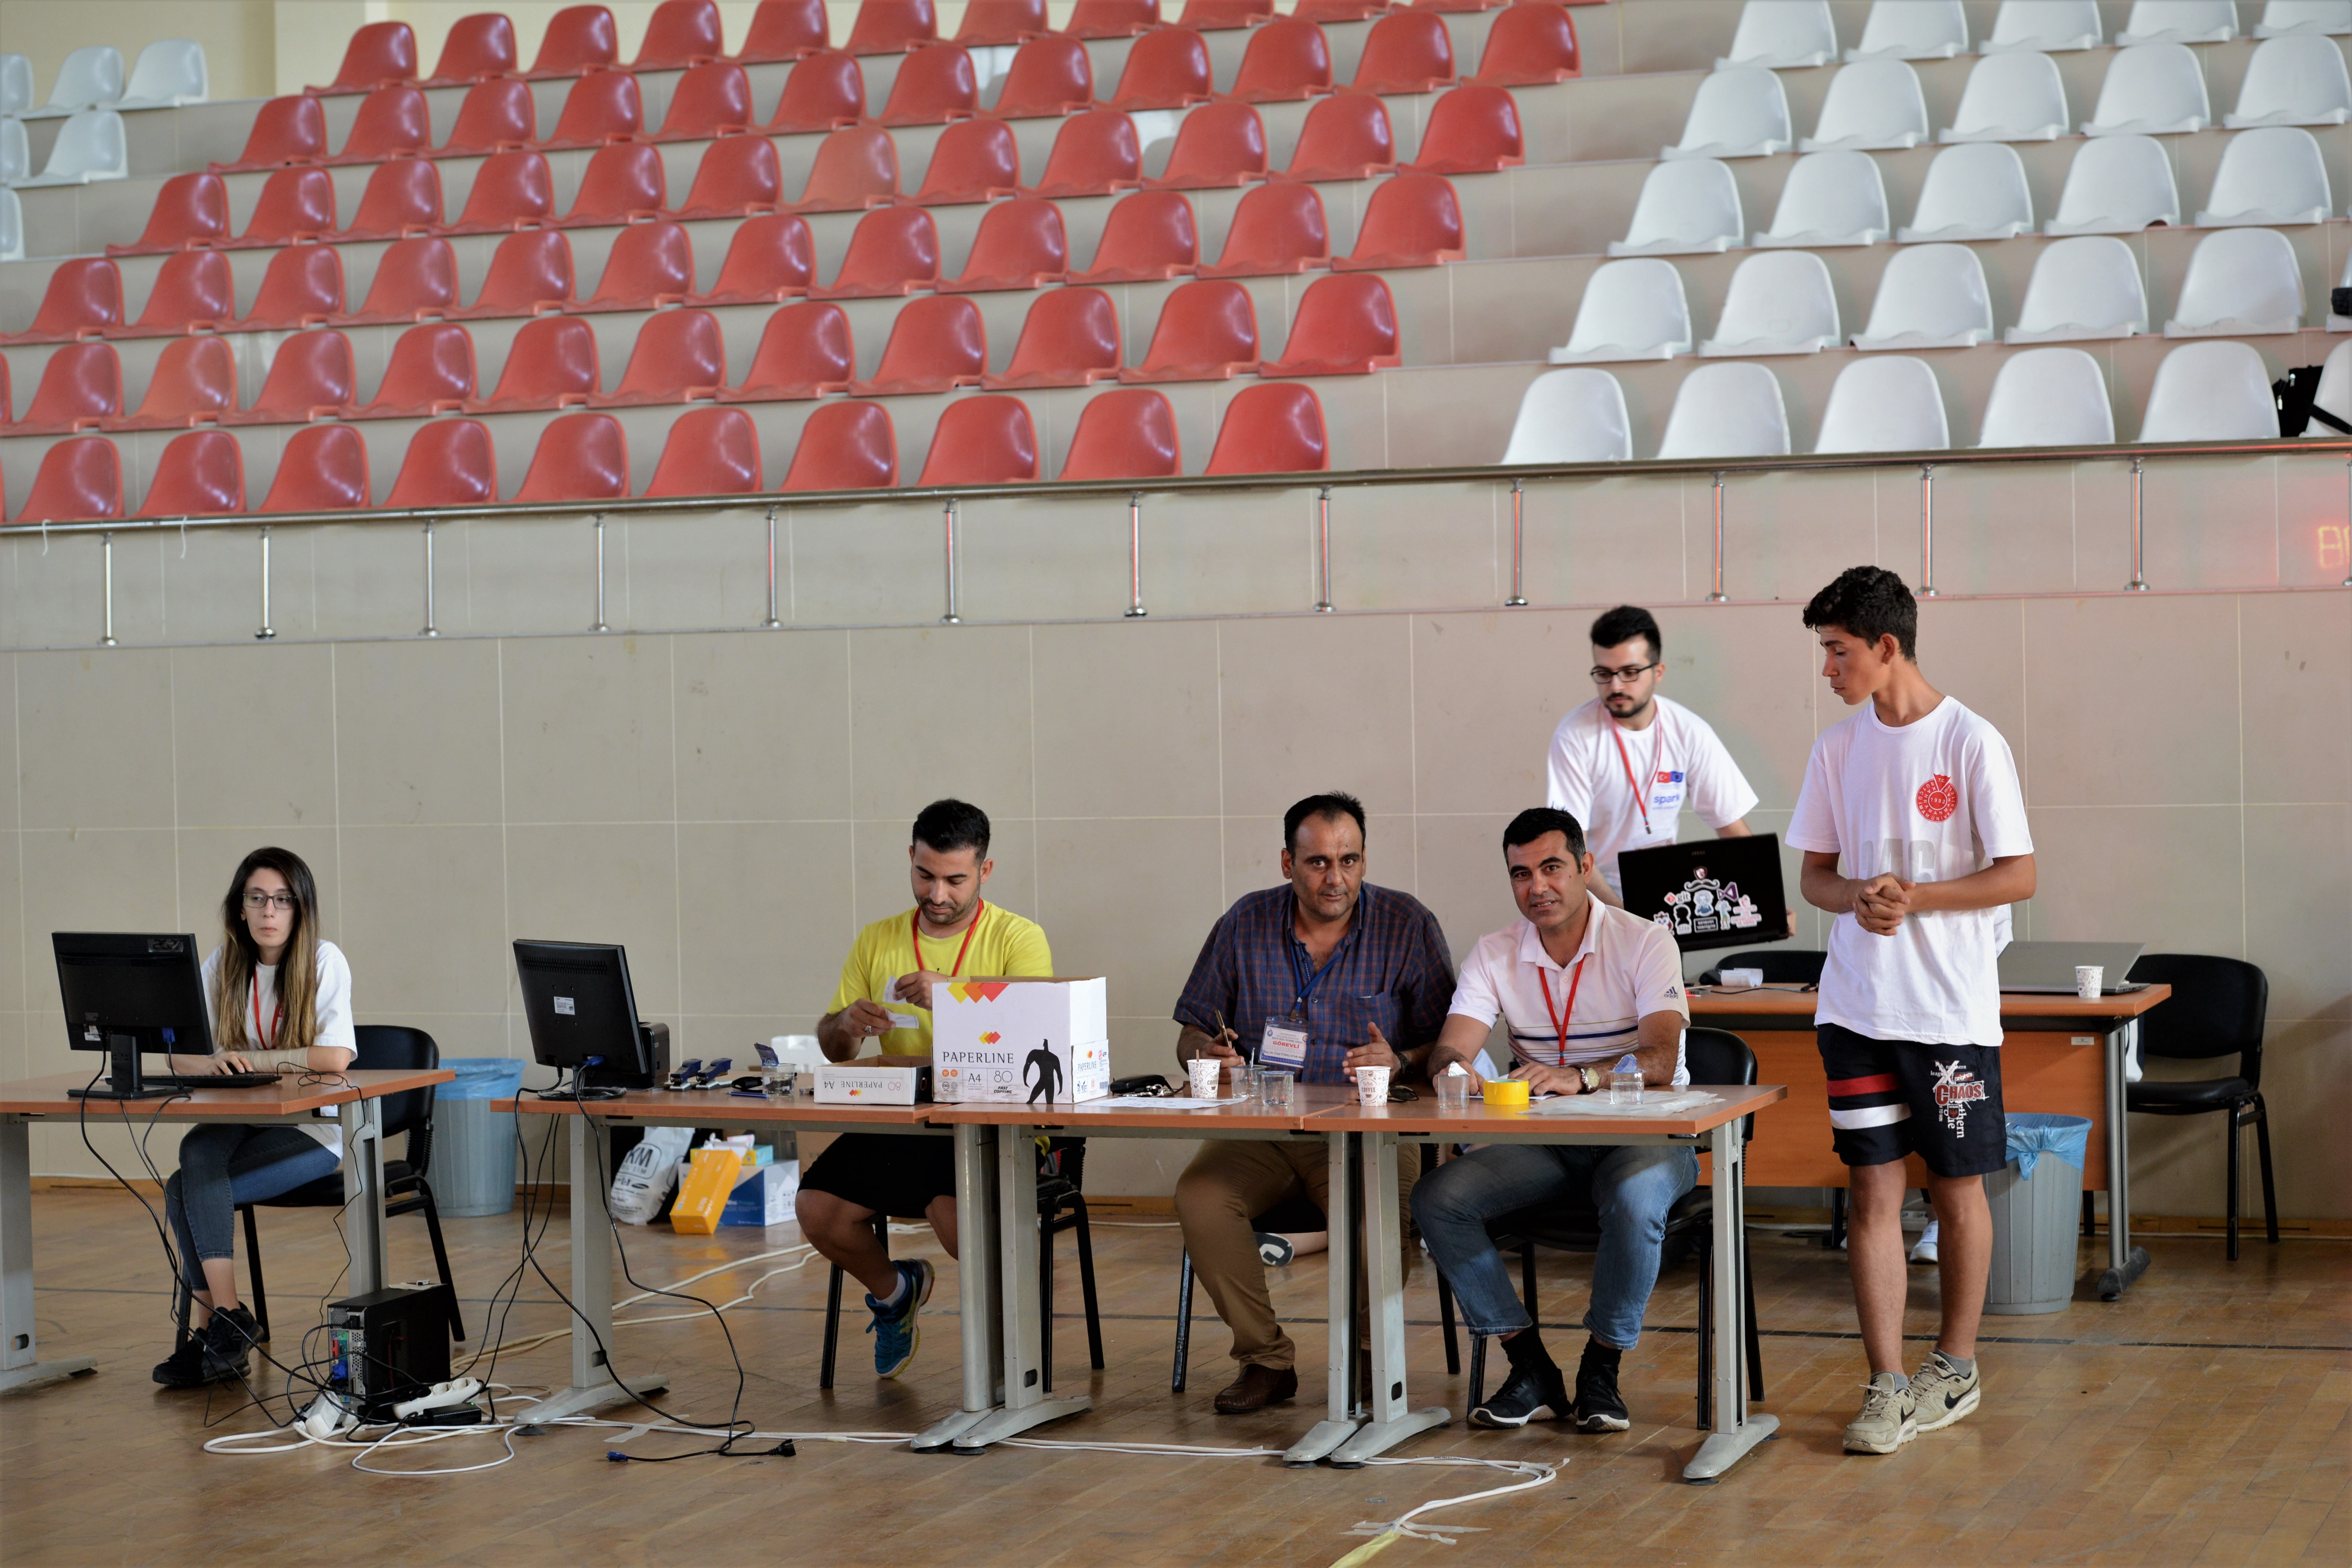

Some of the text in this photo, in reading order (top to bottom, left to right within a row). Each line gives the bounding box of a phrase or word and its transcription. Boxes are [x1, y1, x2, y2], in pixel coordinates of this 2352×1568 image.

[943, 1052, 1014, 1064] PAPERLINE
[1078, 1061, 1097, 1071] PAPERLINE
[968, 1073, 982, 1083] A4
[994, 1070, 1013, 1083] 80
[1954, 1072, 1973, 1081] original
[824, 1081, 835, 1089] A4
[888, 1081, 901, 1091] 80
[1936, 1083, 1983, 1106] CHAOS
